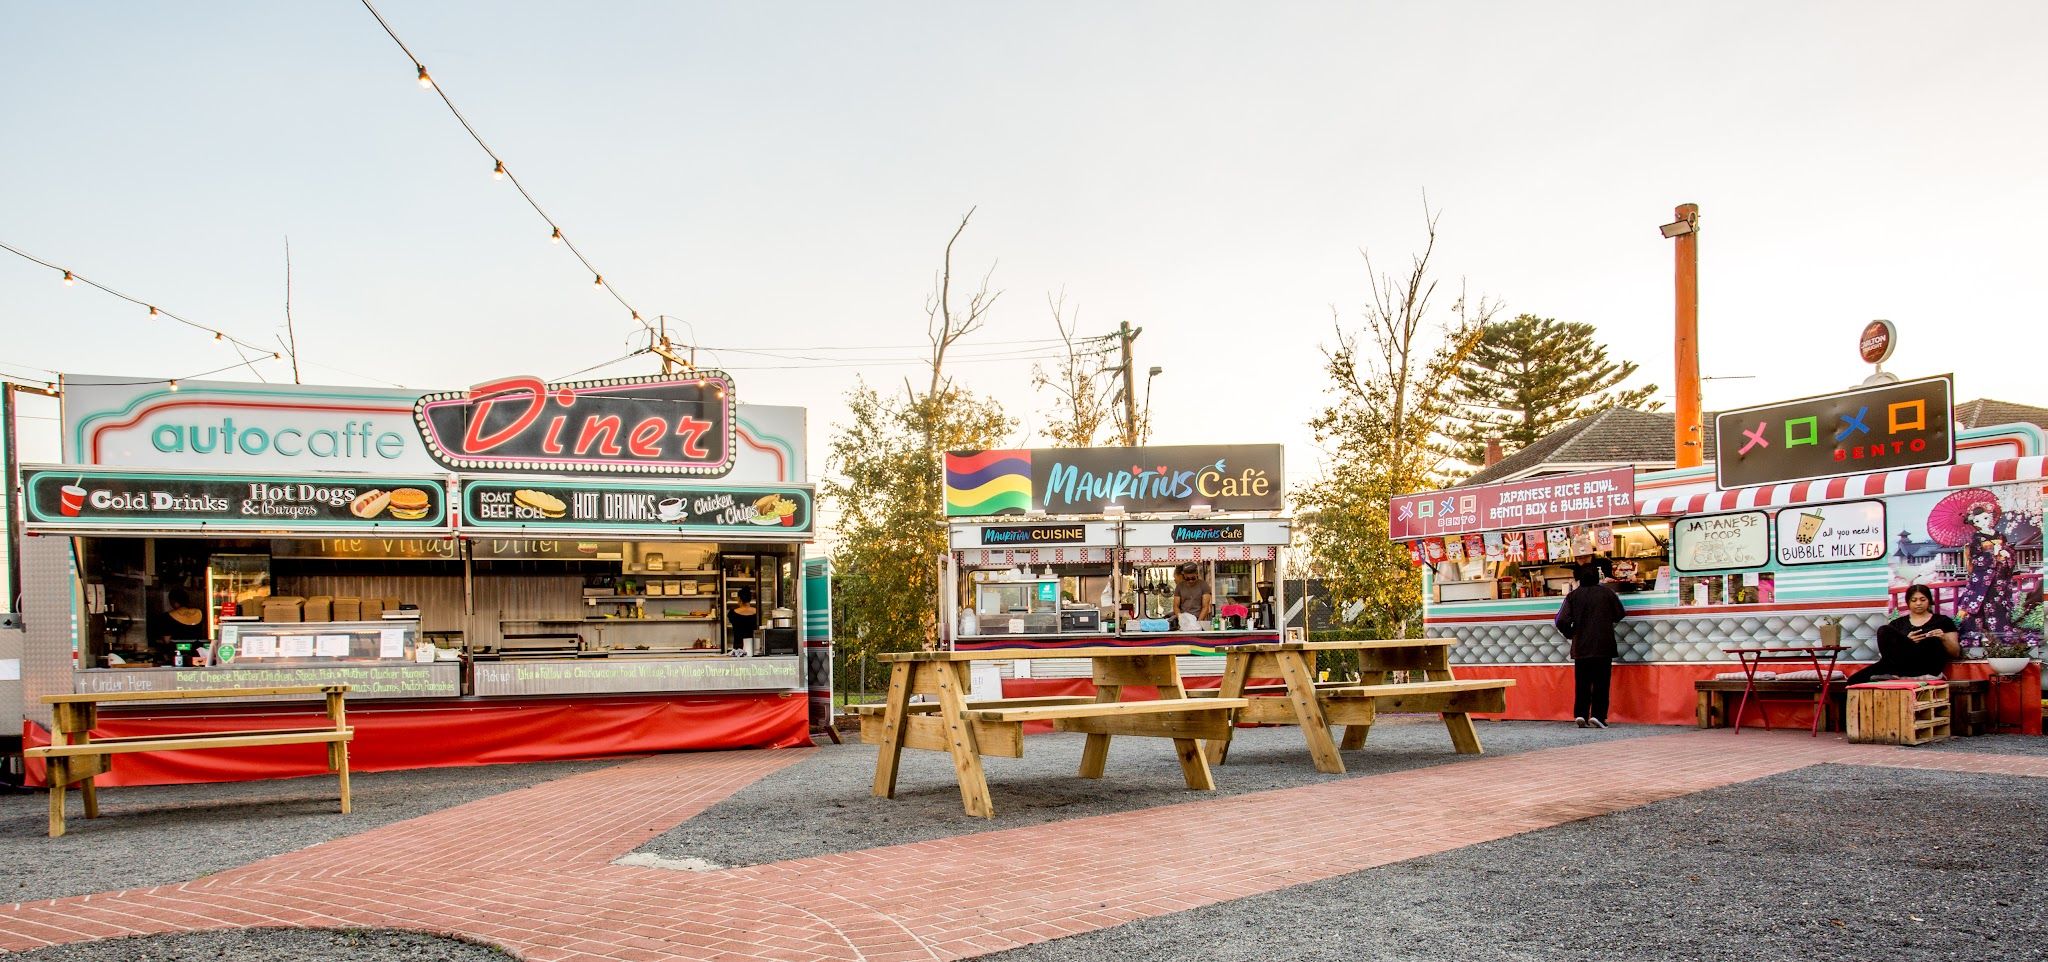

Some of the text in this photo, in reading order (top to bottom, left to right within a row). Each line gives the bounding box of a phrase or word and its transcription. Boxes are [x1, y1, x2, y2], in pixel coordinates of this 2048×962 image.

[463, 375, 713, 458] Diner
[151, 417, 405, 459] autocaffe
[1833, 438, 1926, 463] BENTO
[1198, 466, 1269, 499] Café
[90, 488, 230, 511] Cold Drinks
[249, 482, 356, 507] Hot Dogs
[480, 492, 512, 504] ROAST
[1499, 486, 1552, 506] JAPANESE
[1554, 482, 1581, 498] RICE
[241, 499, 318, 519] & Burgers
[480, 504, 546, 519] BEEF ROLL
[572, 491, 657, 520] HOT DRINKS
[694, 494, 735, 516] Chicken
[715, 503, 760, 525] n Chips
[1489, 493, 1630, 520] BENTO BOX & BUBBLE TEA
[1438, 515, 1476, 527] BENTO
[1687, 515, 1759, 532] JAPANESE
[1031, 528, 1083, 540] CUISINE
[1220, 527, 1243, 539] Café
[1704, 528, 1742, 540] FOODS
[1822, 525, 1879, 540] all you need is
[1782, 543, 1880, 561] BUBBLE MILK TEA
[127, 676, 152, 691] Here
